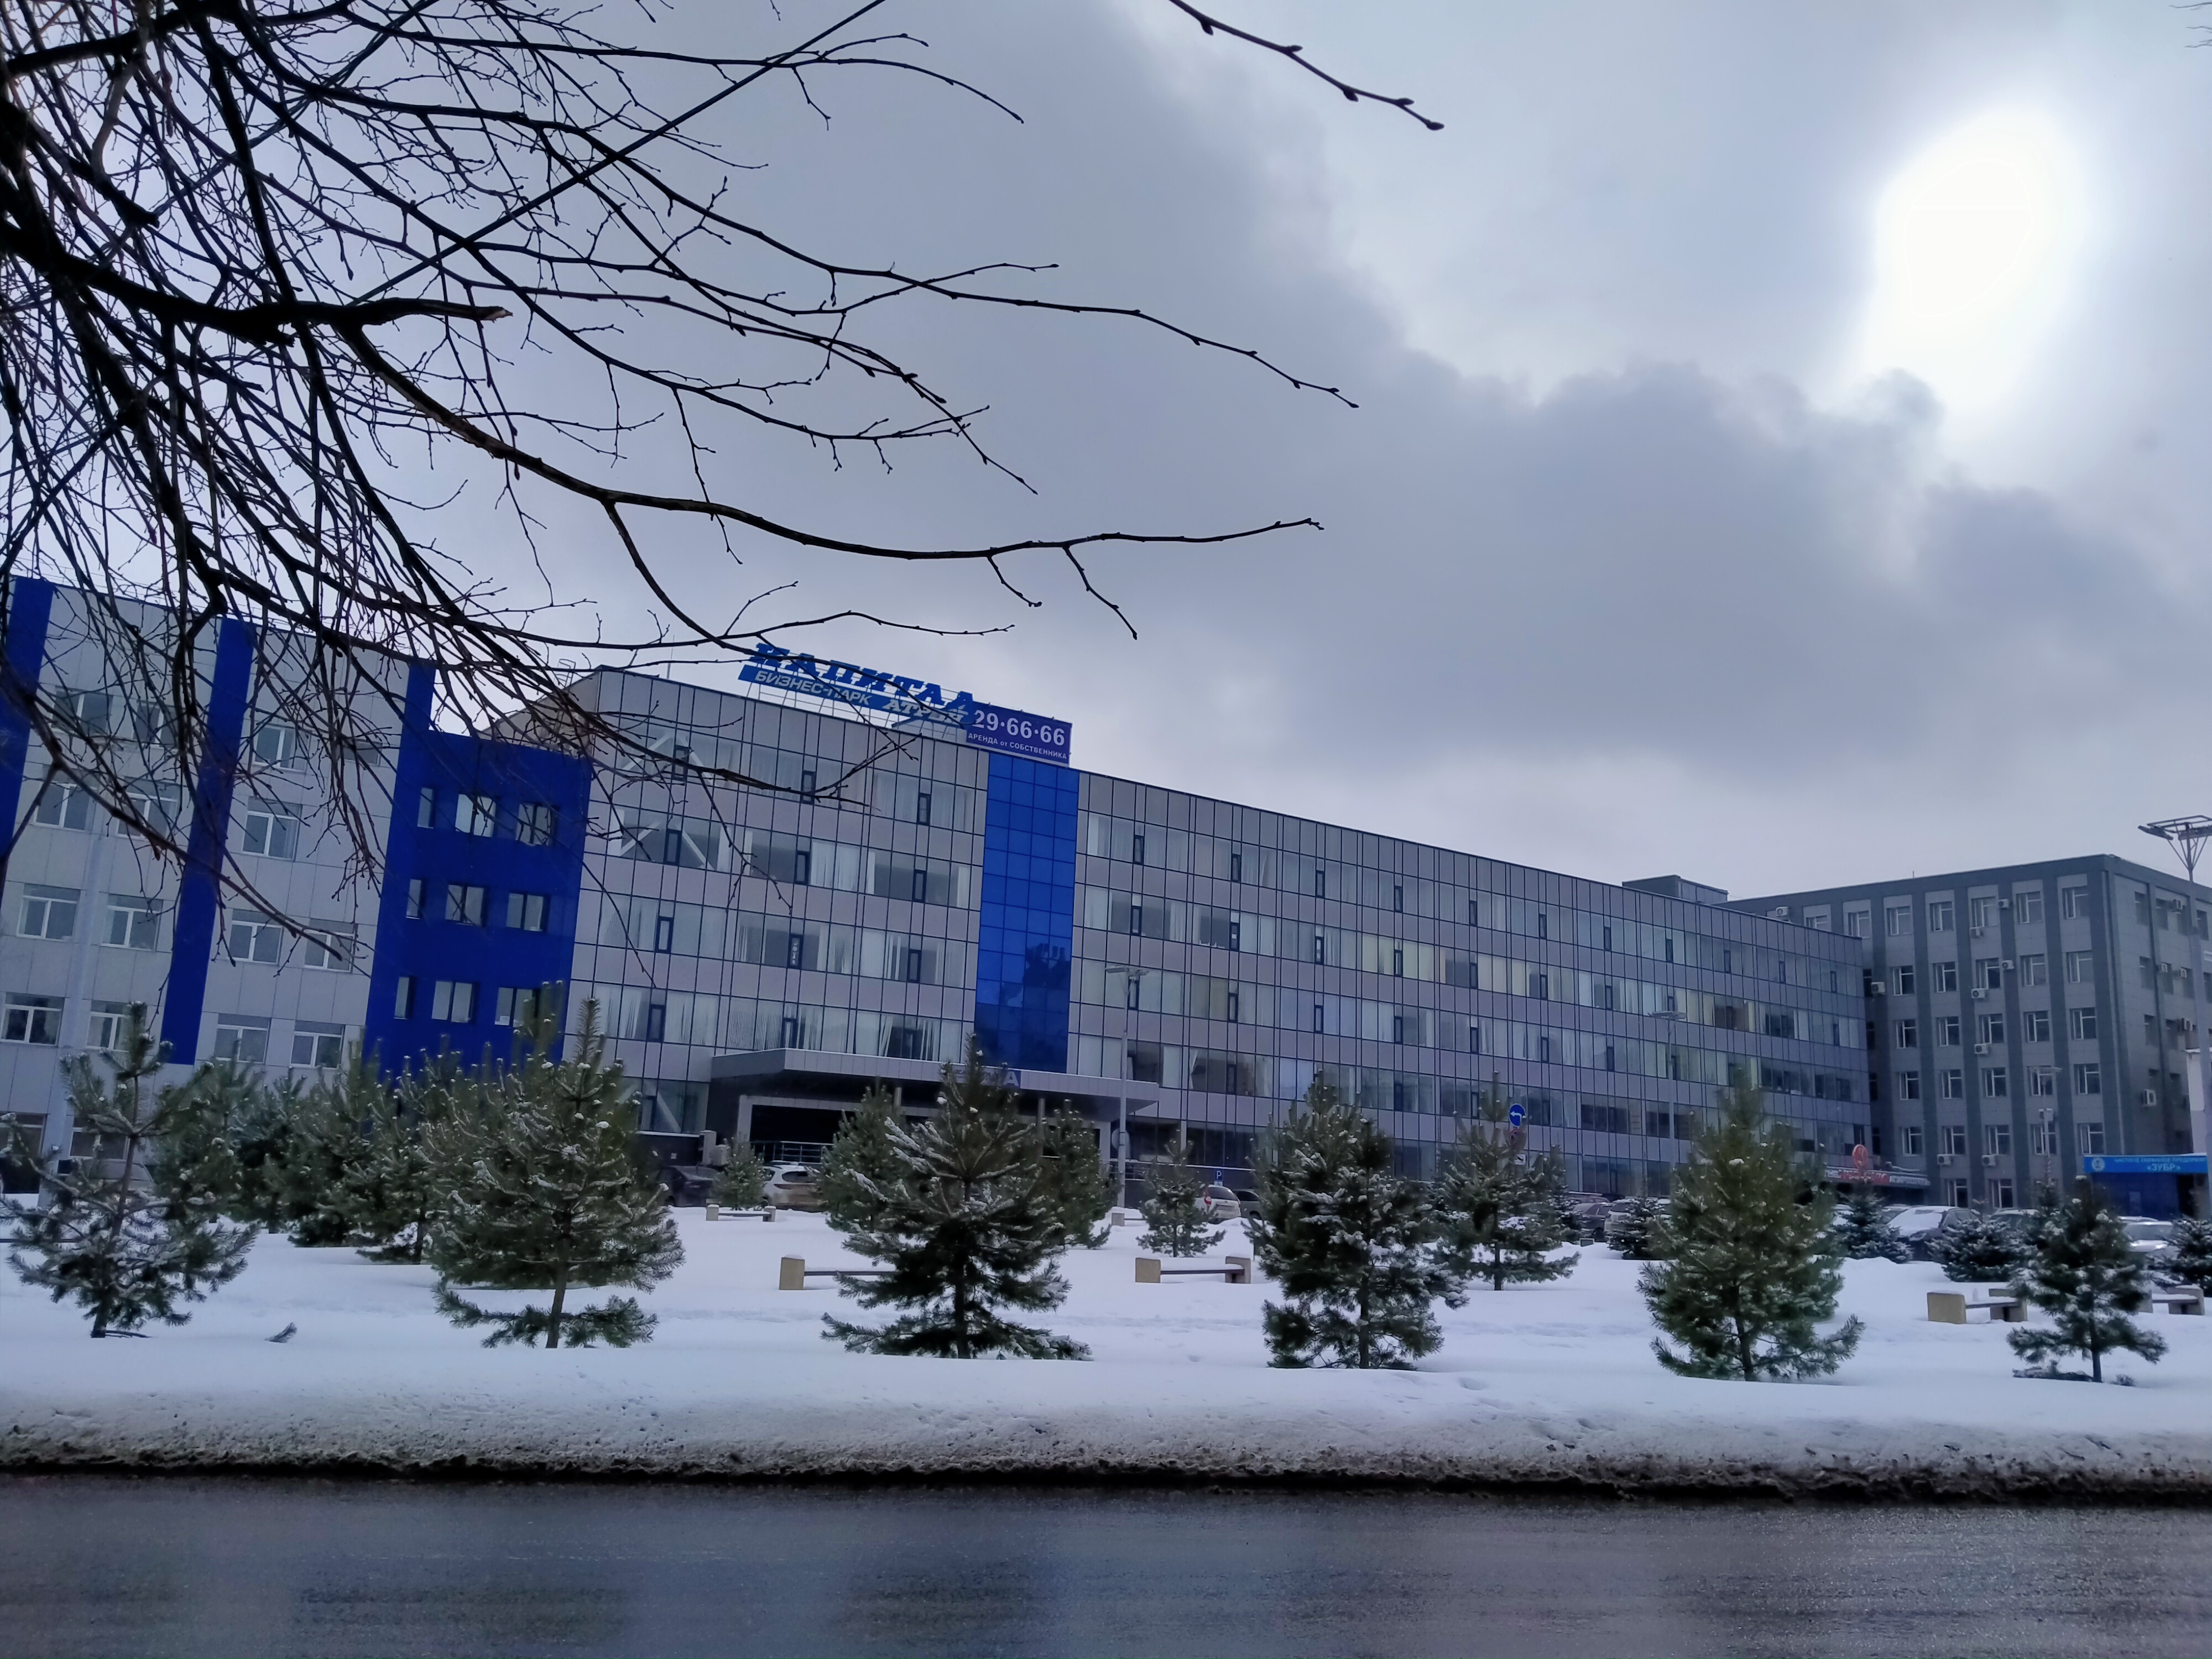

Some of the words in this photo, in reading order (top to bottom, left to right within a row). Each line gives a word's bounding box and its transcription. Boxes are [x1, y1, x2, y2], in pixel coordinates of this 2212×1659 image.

[755, 670, 872, 706] БИЗНЕС-ПАРК
[968, 733, 998, 745] АРЕНДА
[1010, 742, 1067, 760] СОБСТВЕННИКА
[1217, 1170, 1222, 1180] P
